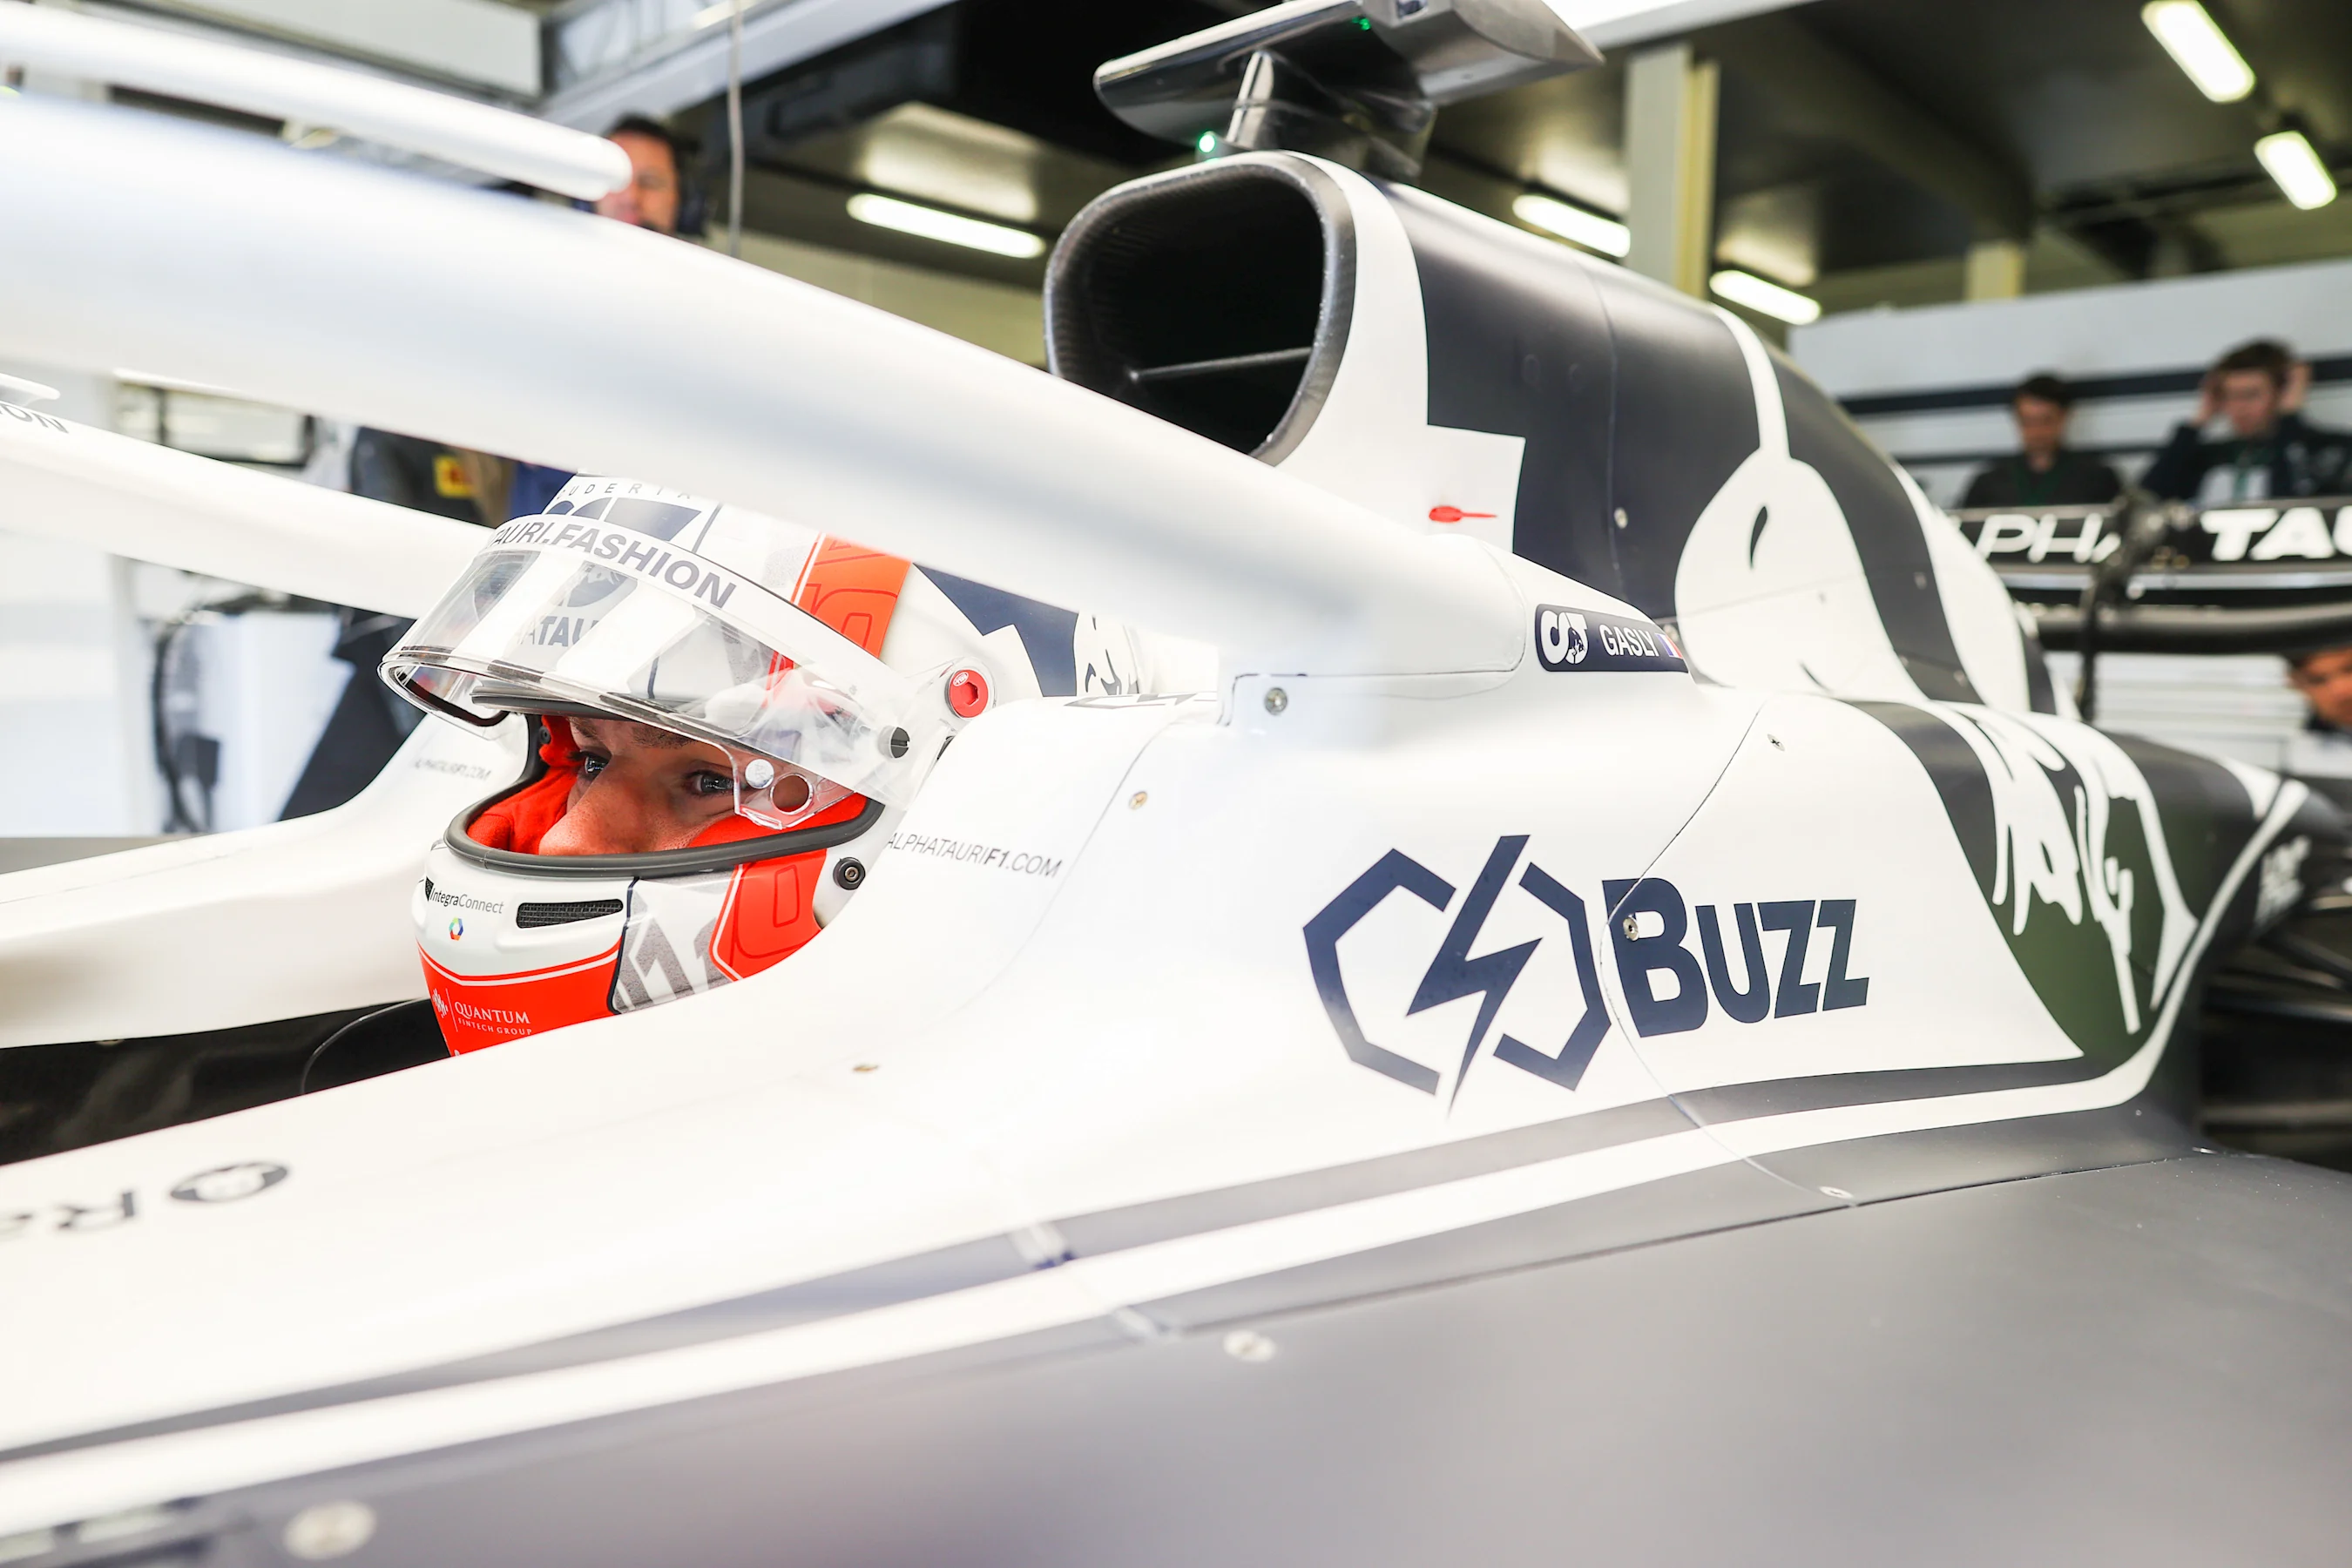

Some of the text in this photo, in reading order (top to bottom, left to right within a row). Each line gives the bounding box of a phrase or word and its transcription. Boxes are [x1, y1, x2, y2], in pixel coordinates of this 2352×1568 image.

[0, 402, 70, 434] ON
[1598, 624, 1660, 657] GASLY
[883, 832, 1063, 878] ALPHATAURIF1.COM
[429, 887, 504, 915] IntegraConnect
[454, 1001, 531, 1024] QUANTUM
[457, 1017, 532, 1036] FINTECH GROUP
